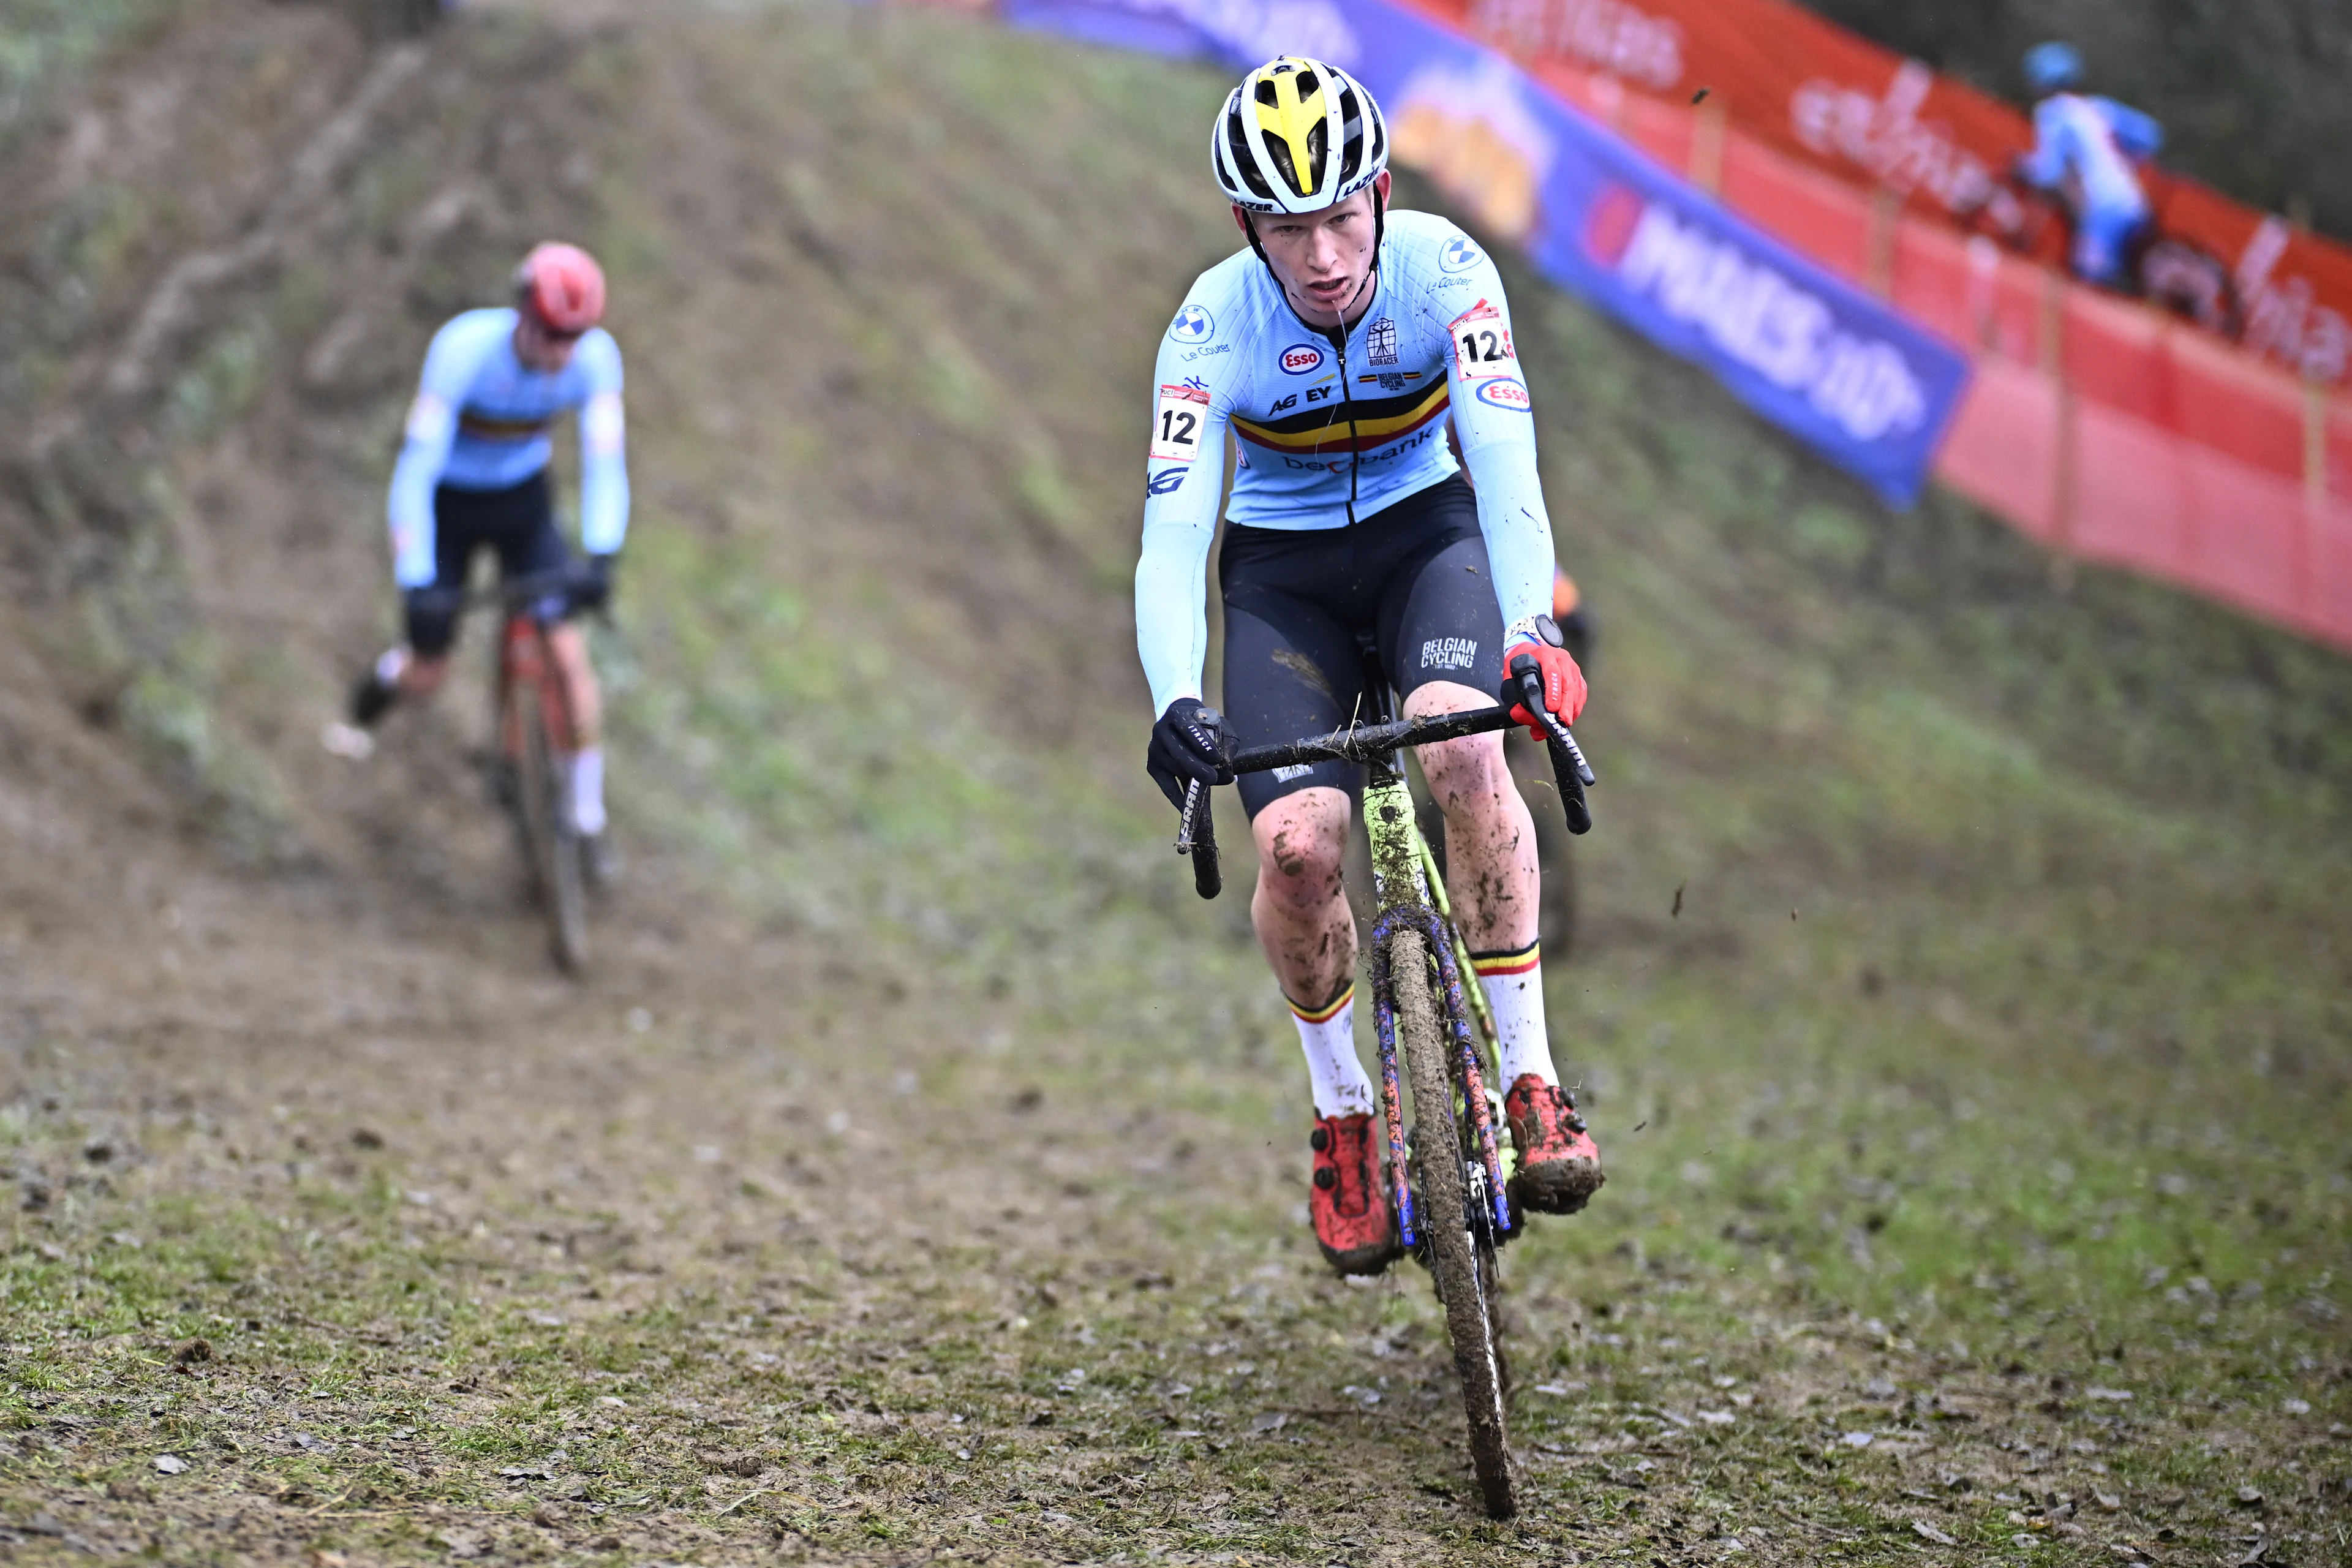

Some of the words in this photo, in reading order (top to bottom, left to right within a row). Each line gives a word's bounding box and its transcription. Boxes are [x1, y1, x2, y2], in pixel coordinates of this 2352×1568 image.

[1343, 165, 1379, 197] LAZER
[1234, 198, 1273, 211] LAZER
[1463, 330, 1503, 363] 12
[1369, 356, 1399, 366] BIORACER
[1378, 372, 1403, 381] BELGIAN
[1380, 380, 1406, 388] CYCLING
[1268, 394, 1297, 417] AG
[1306, 386, 1331, 402] EY
[1163, 410, 1196, 445] 12
[1422, 637, 1477, 656] BELGIAN
[1421, 651, 1474, 668] CYCLING
[1188, 725, 1213, 752] ITRACK
[1543, 712, 1586, 767] SRAM
